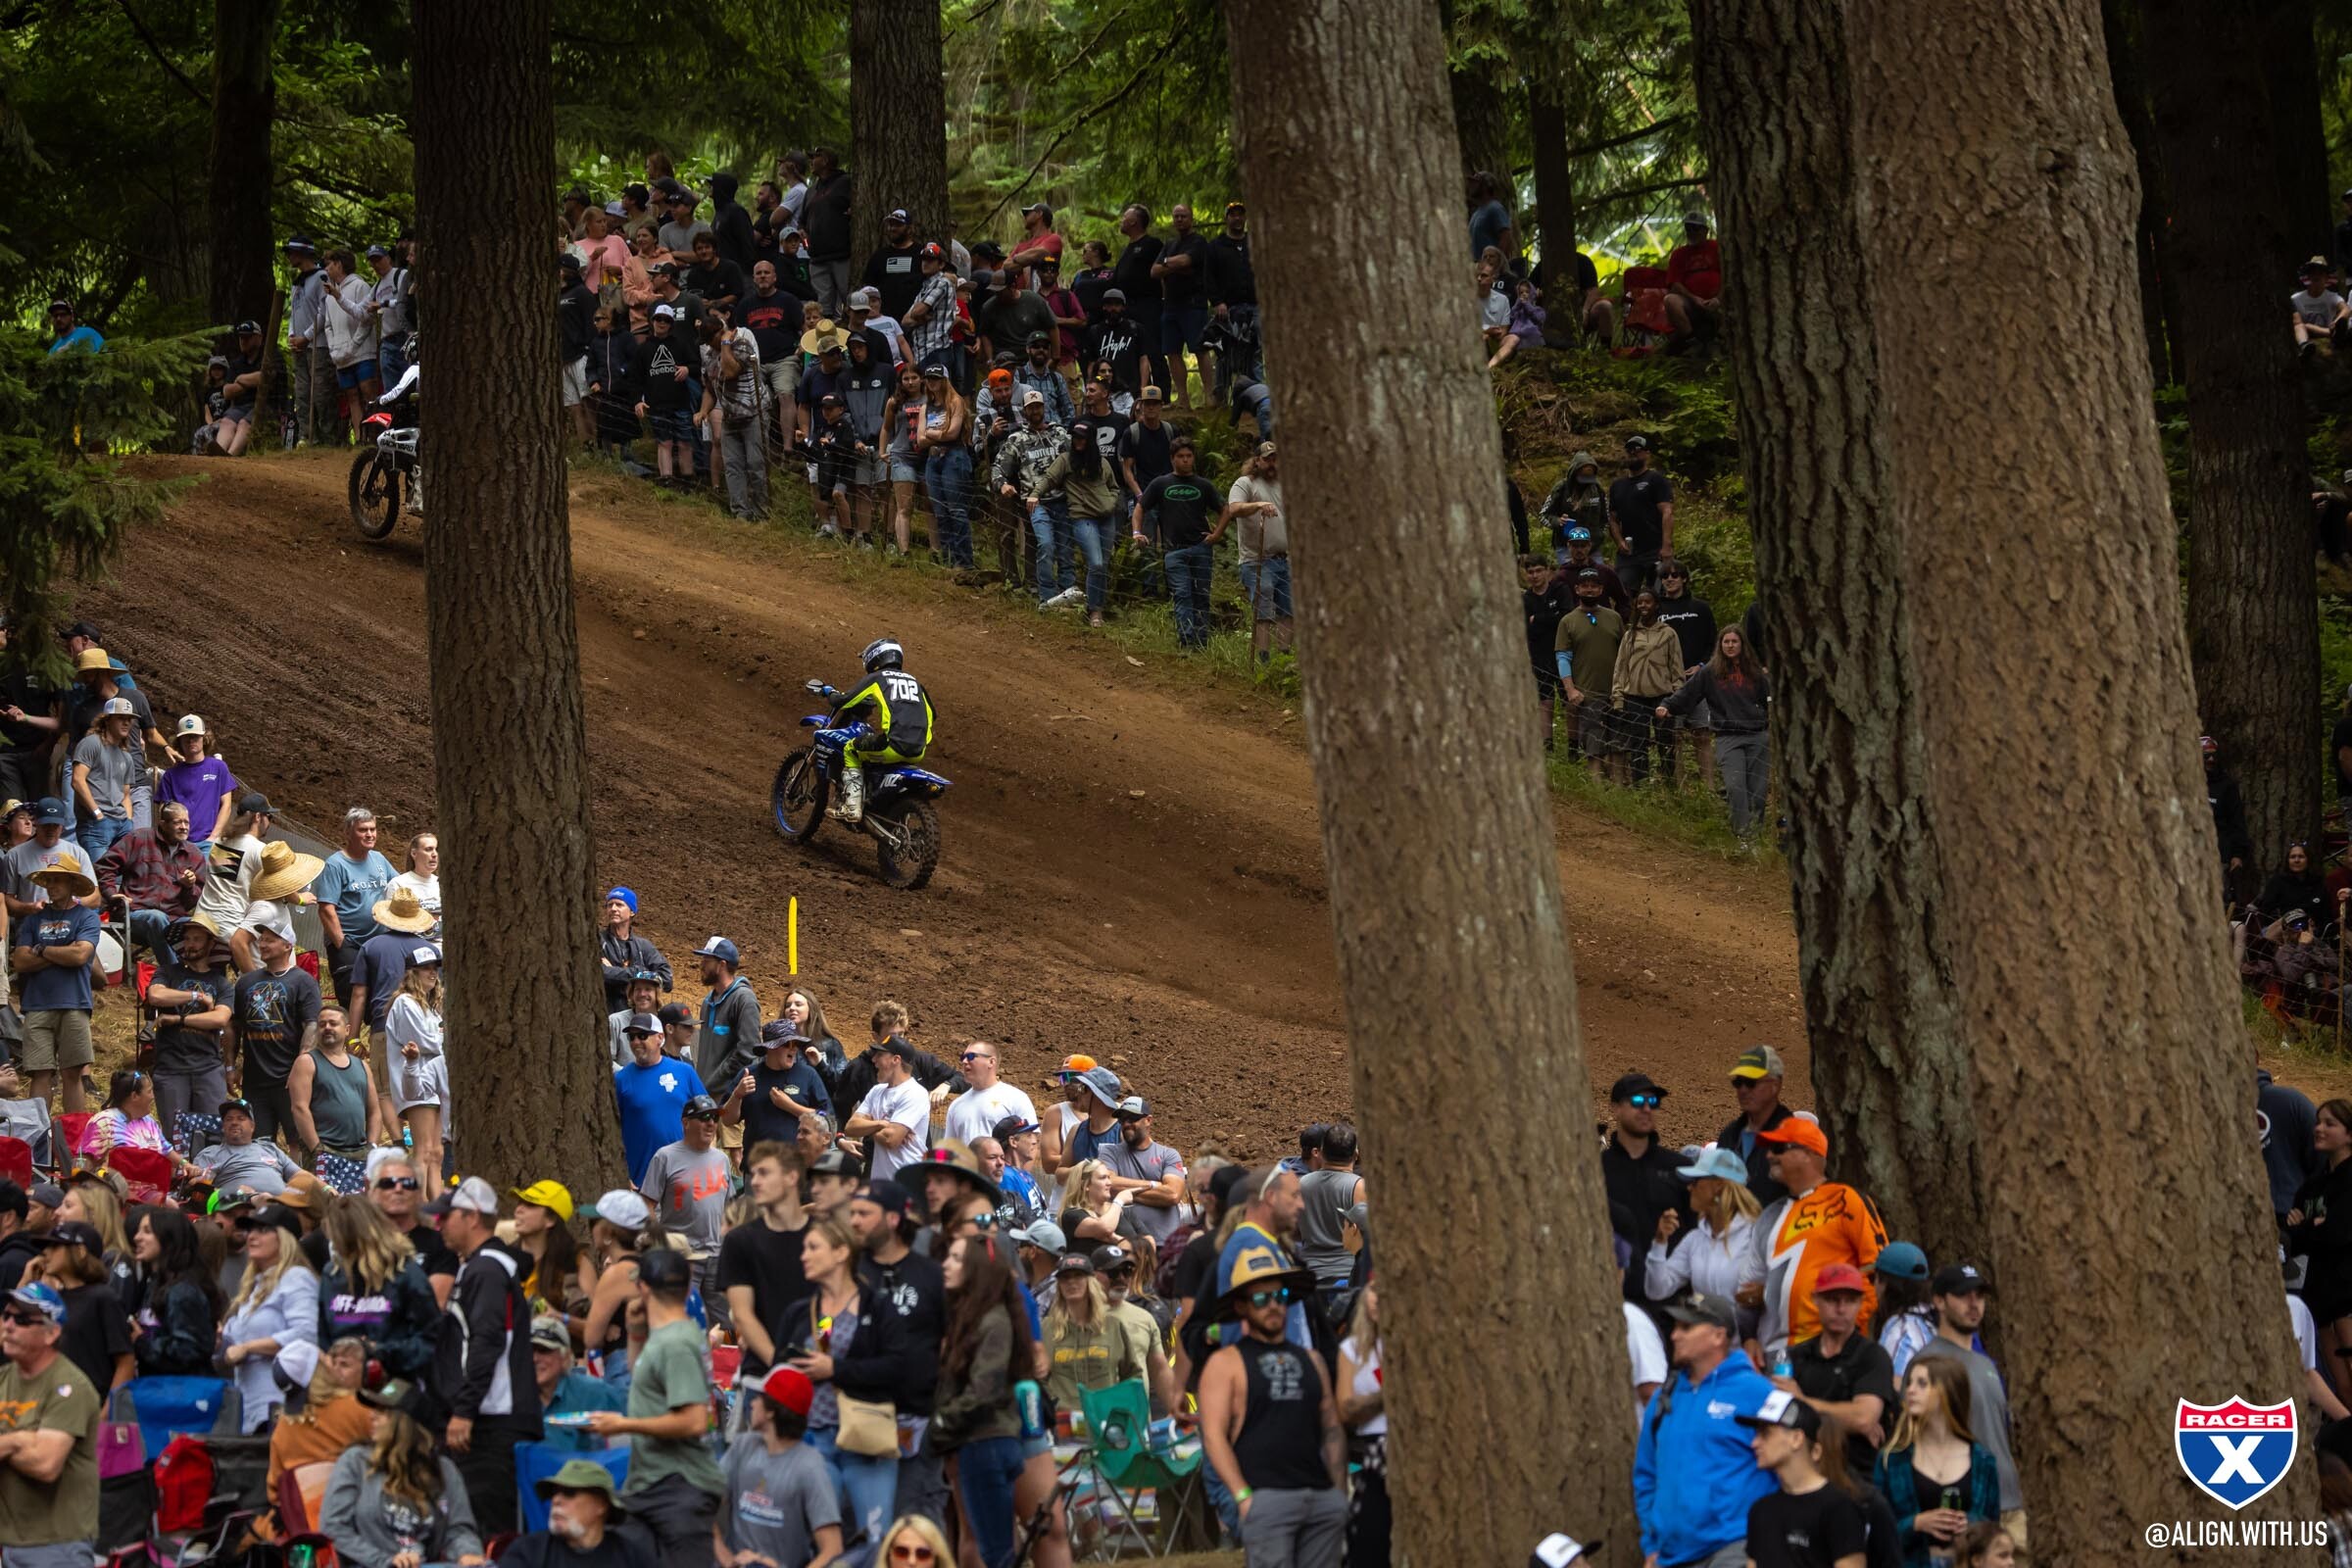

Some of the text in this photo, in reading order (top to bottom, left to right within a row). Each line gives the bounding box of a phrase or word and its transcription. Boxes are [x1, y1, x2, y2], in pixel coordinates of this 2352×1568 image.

[1100, 330, 1132, 361] High!
[650, 365, 677, 376] Reebo
[886, 676, 920, 703] 702
